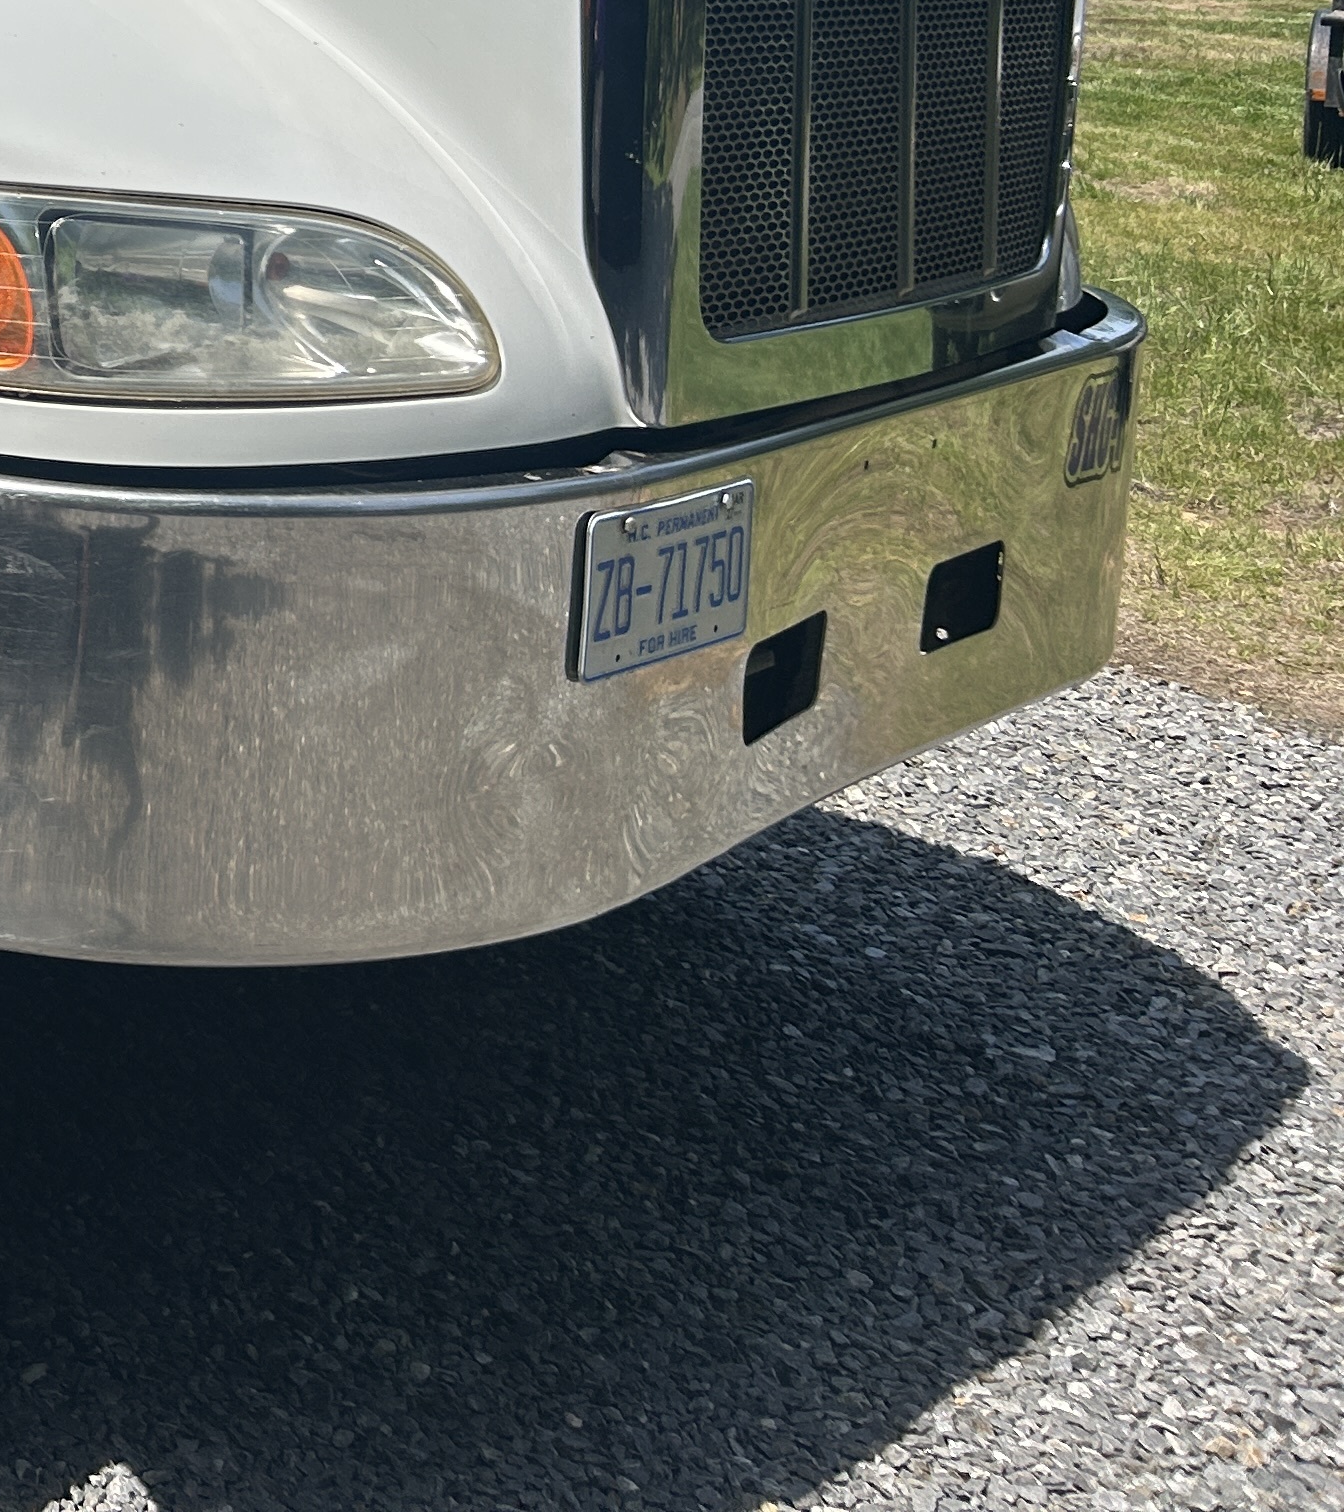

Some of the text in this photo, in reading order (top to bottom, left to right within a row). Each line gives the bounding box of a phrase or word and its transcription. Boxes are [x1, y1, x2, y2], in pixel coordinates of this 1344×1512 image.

[657, 505, 719, 537] PERMANENT
[593, 525, 744, 643] ZB-71750
[638, 624, 698, 657] FOR HIRE
